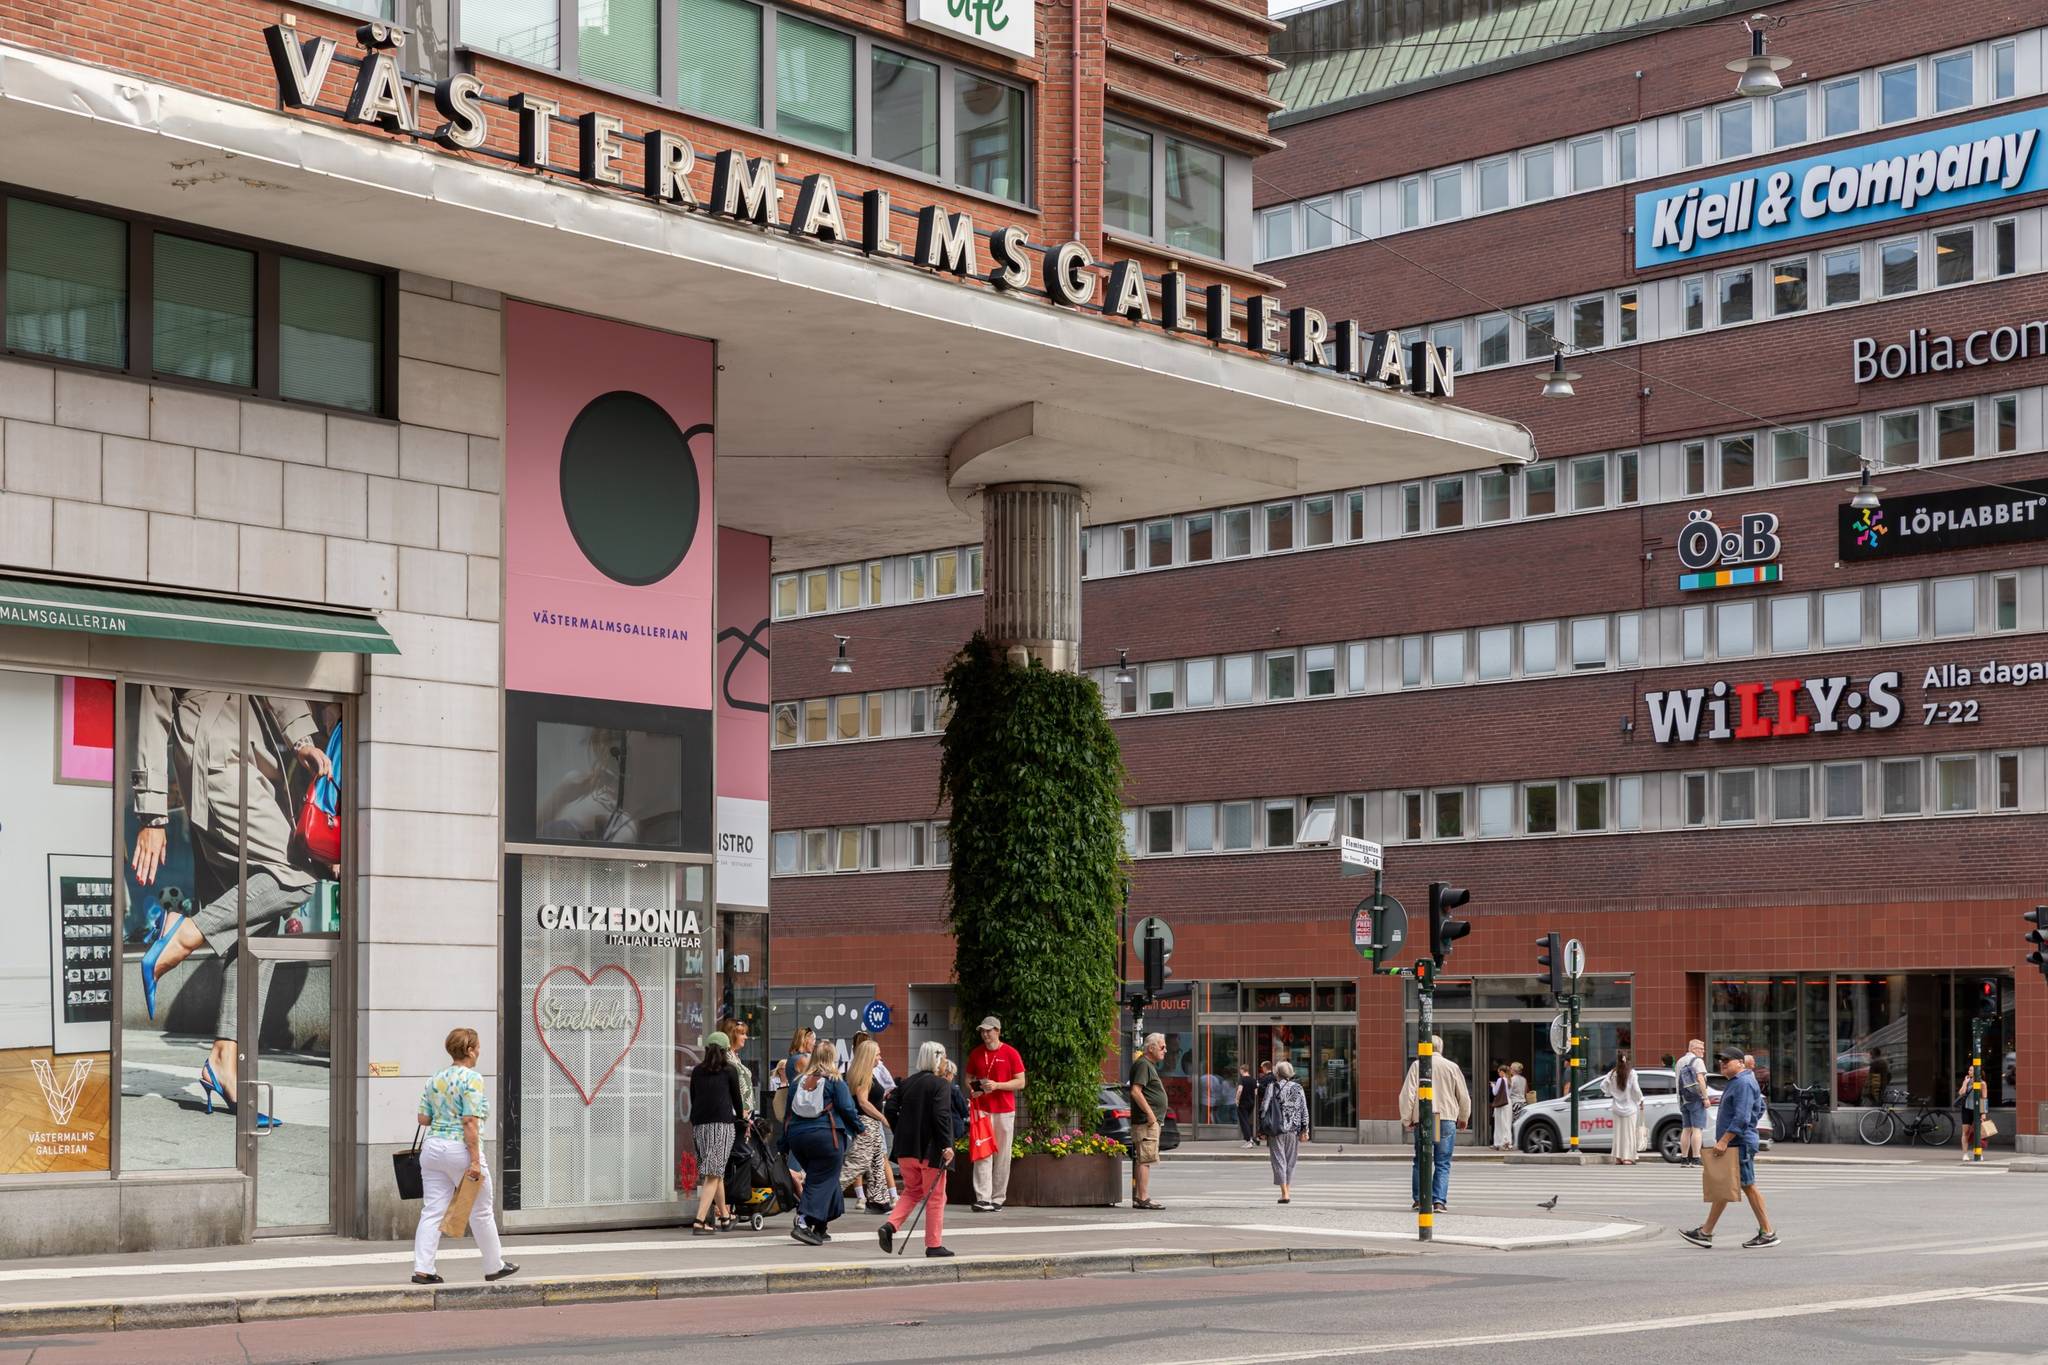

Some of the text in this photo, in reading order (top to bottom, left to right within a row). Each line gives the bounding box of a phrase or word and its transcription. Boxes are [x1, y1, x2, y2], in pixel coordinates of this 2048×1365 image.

[1651, 127, 2040, 252] Kjell & Company
[263, 20, 1456, 399] VÄSTERMALMSGALLERIAN
[0, 606, 127, 632] MALMSGALLERIAN
[532, 609, 689, 641] VÄSTERMALMSGALLERIAN
[1921, 660, 2048, 690] Alla daga
[1922, 699, 1980, 727] 7-22
[538, 903, 700, 935] CALZEDONIA
[608, 934, 701, 949] ITALIAN LEGWEAR
[1160, 999, 1191, 1010] OUTLET
[911, 1012, 929, 1027] 44
[28, 1131, 96, 1143] VÄSTERMALMS
[1580, 1117, 1614, 1133] nytta
[36, 1145, 88, 1156] GALLERIAN
